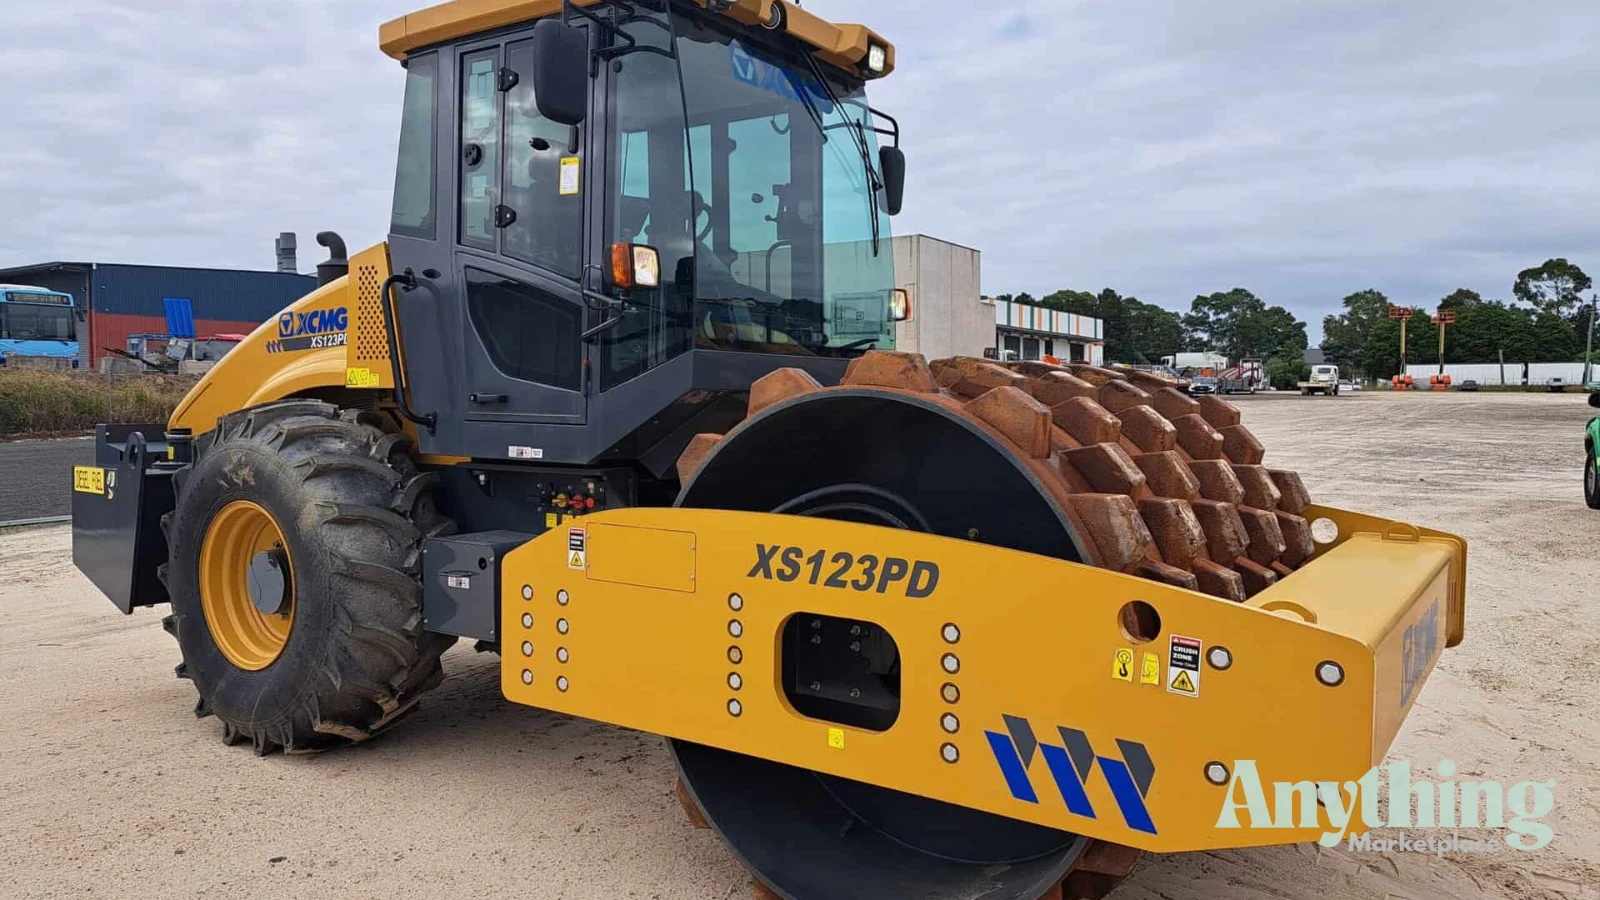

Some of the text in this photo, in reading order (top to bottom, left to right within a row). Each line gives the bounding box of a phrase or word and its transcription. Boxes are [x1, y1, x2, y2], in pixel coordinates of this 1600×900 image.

[296, 307, 348, 336] XCMG
[747, 543, 940, 598] XS123PD
[1173, 645, 1198, 656] CRUSH
[1173, 652, 1193, 662] ZONE
